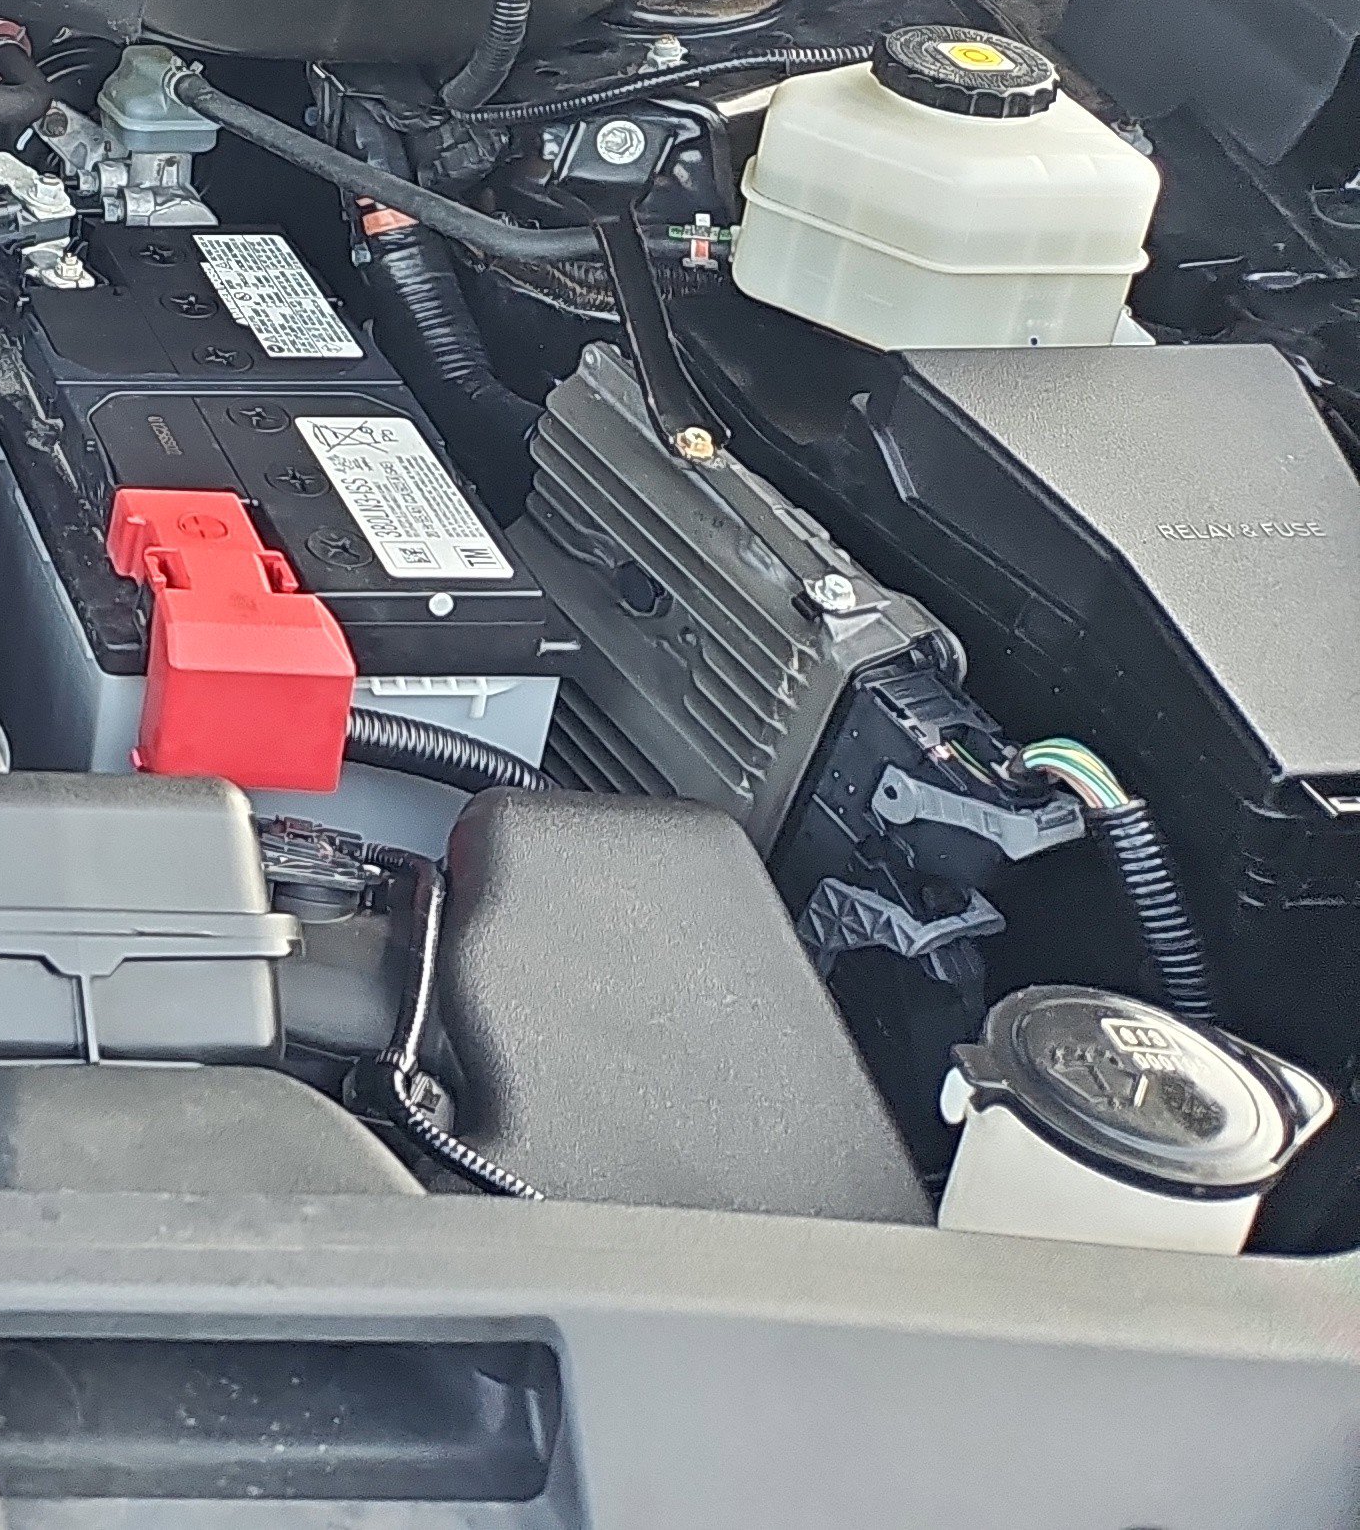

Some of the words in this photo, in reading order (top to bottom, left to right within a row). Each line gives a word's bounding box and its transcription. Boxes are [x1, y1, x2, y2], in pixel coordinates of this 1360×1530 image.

[1157, 523, 1235, 539] RELAY
[1240, 523, 1258, 538] &
[1259, 522, 1327, 537] FUSE
[460, 548, 497, 567] TM
